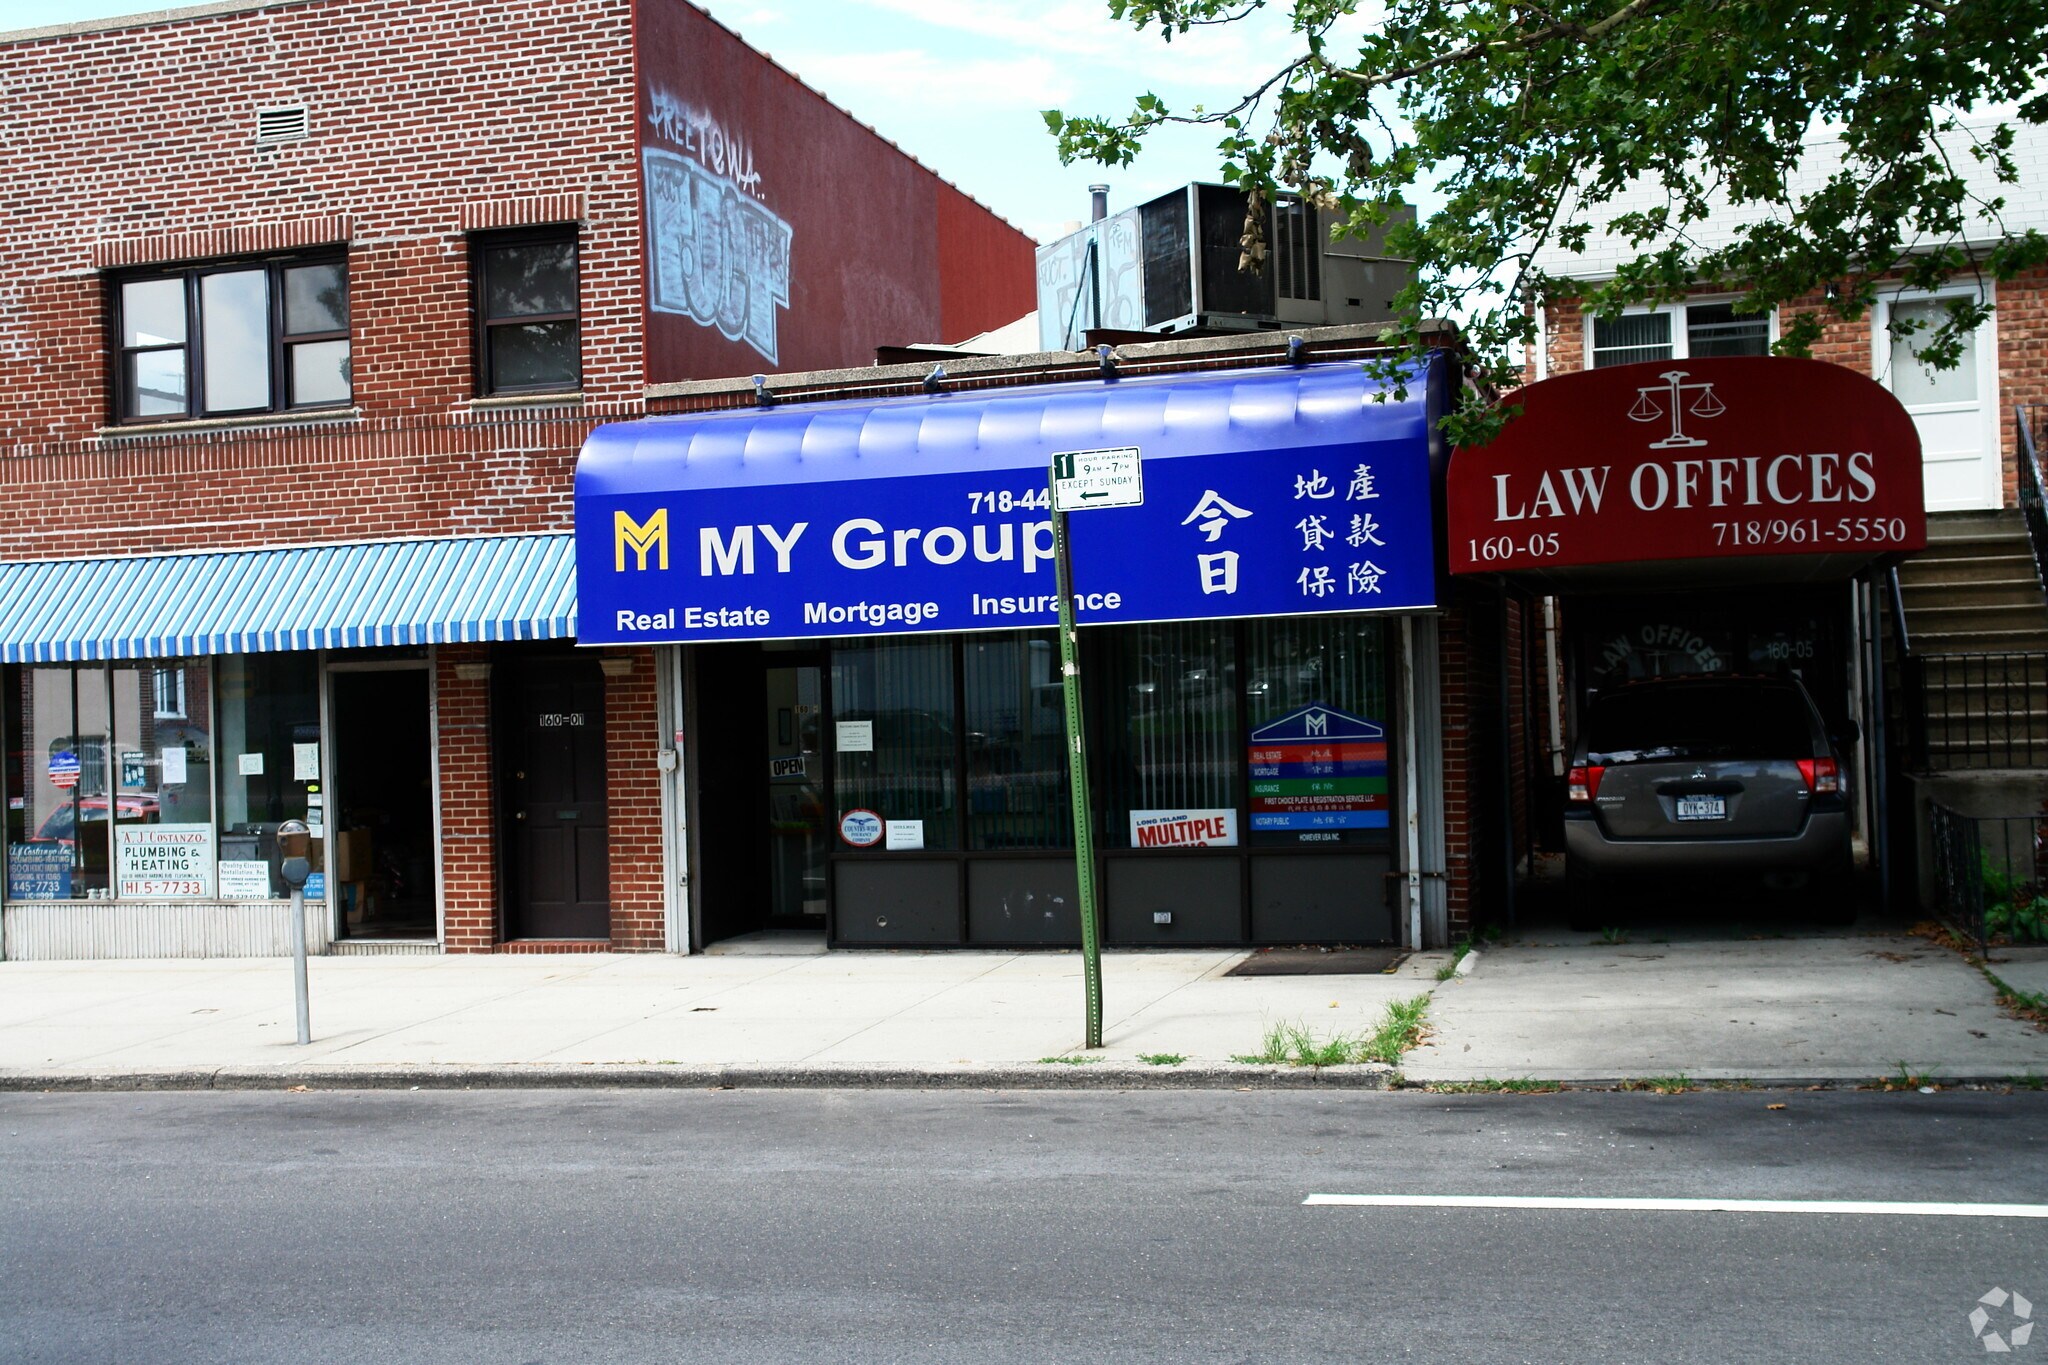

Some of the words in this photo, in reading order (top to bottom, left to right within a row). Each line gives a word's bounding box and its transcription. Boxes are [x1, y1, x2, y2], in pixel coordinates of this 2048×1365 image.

[1078, 455, 1098, 463] HOUR
[1101, 452, 1134, 461] PARKING
[1061, 478, 1094, 490] EXCEPT
[1099, 475, 1134, 487] SUNDAY
[1493, 466, 1611, 522] LAW
[1630, 452, 1877, 511] OFFICES
[700, 522, 809, 577] MY
[832, 518, 1056, 573] Group
[1181, 489, 1253, 595] 今日
[1469, 533, 1560, 562] 160-05
[1712, 518, 1906, 546] 718/961-5550
[616, 608, 675, 631] Real
[685, 605, 771, 629] Estate
[804, 602, 940, 627] Mortgage
[1641, 624, 1722, 673] OFFICES
[773, 758, 804, 776] OPEN
[1255, 784, 1280, 793] INSURANCE
[1278, 796, 1294, 804] CHOICE
[1295, 796, 1309, 804] PLATE
[1345, 795, 1364, 803] SERVICE
[1160, 815, 1188, 823] ISLAND
[1137, 816, 1227, 848] MULTIPLE
[125, 847, 186, 857] PLUMBING
[131, 860, 189, 870] HEATING
[12, 881, 60, 892] 445-7733
